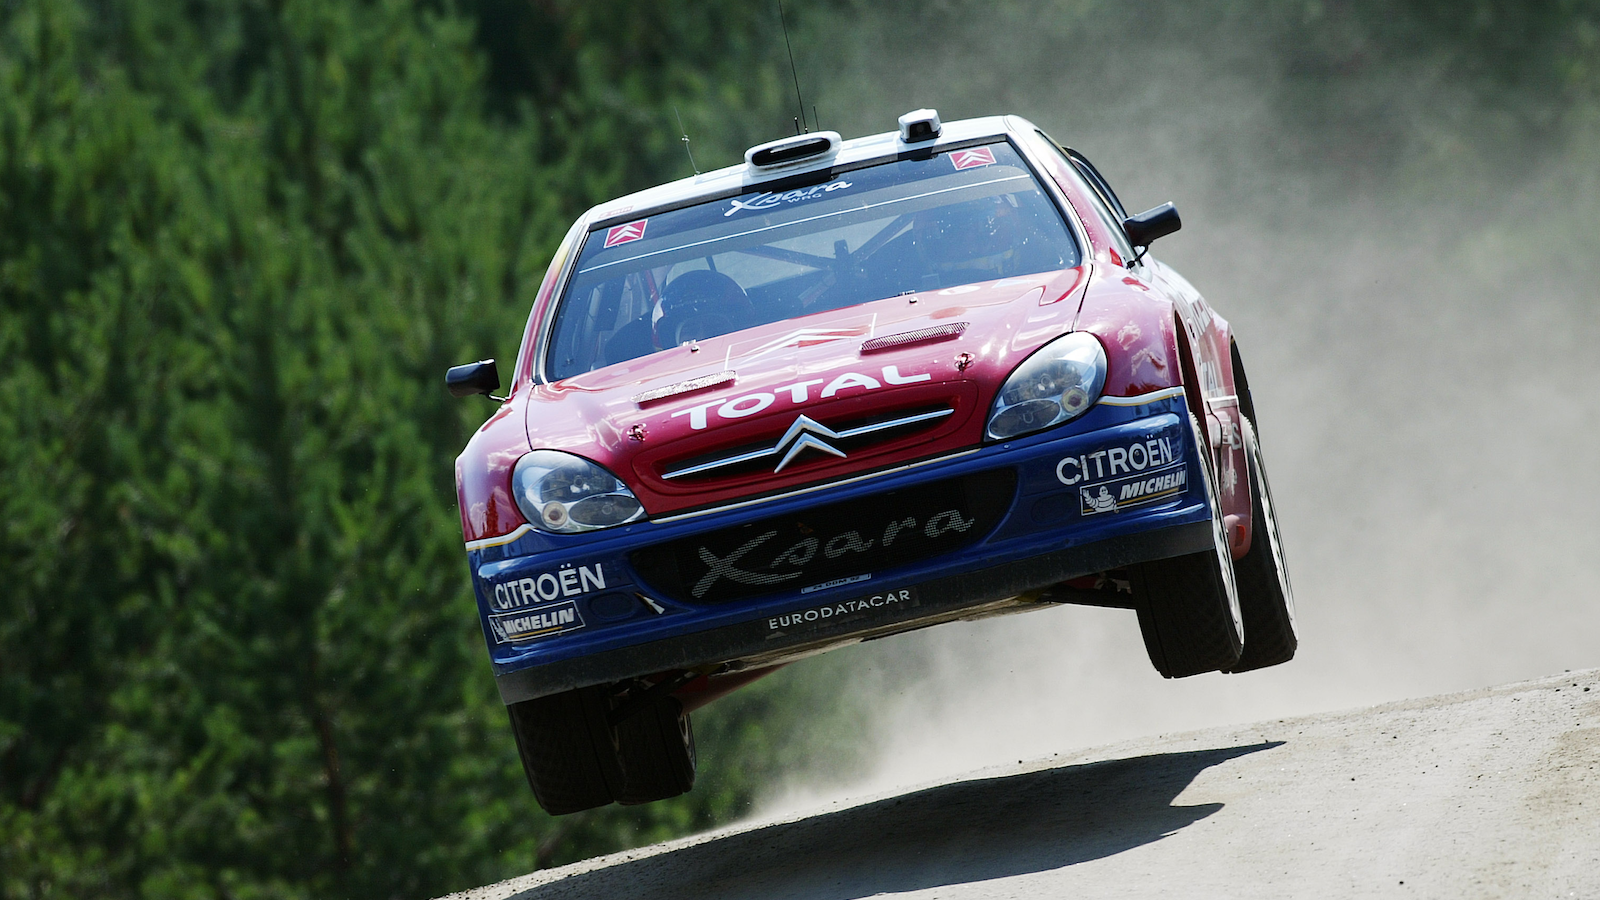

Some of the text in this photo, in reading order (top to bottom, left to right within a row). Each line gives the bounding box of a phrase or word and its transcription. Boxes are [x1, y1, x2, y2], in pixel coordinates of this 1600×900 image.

[723, 180, 853, 217] Xsara
[671, 365, 932, 430] TOTAL
[1055, 434, 1173, 486] CITROËN
[1119, 469, 1187, 500] MICHELIN
[691, 509, 975, 599] Xsara
[494, 562, 606, 610] CITROËN
[502, 607, 575, 637] MICHELIN
[768, 589, 910, 630] EURODATACAR
